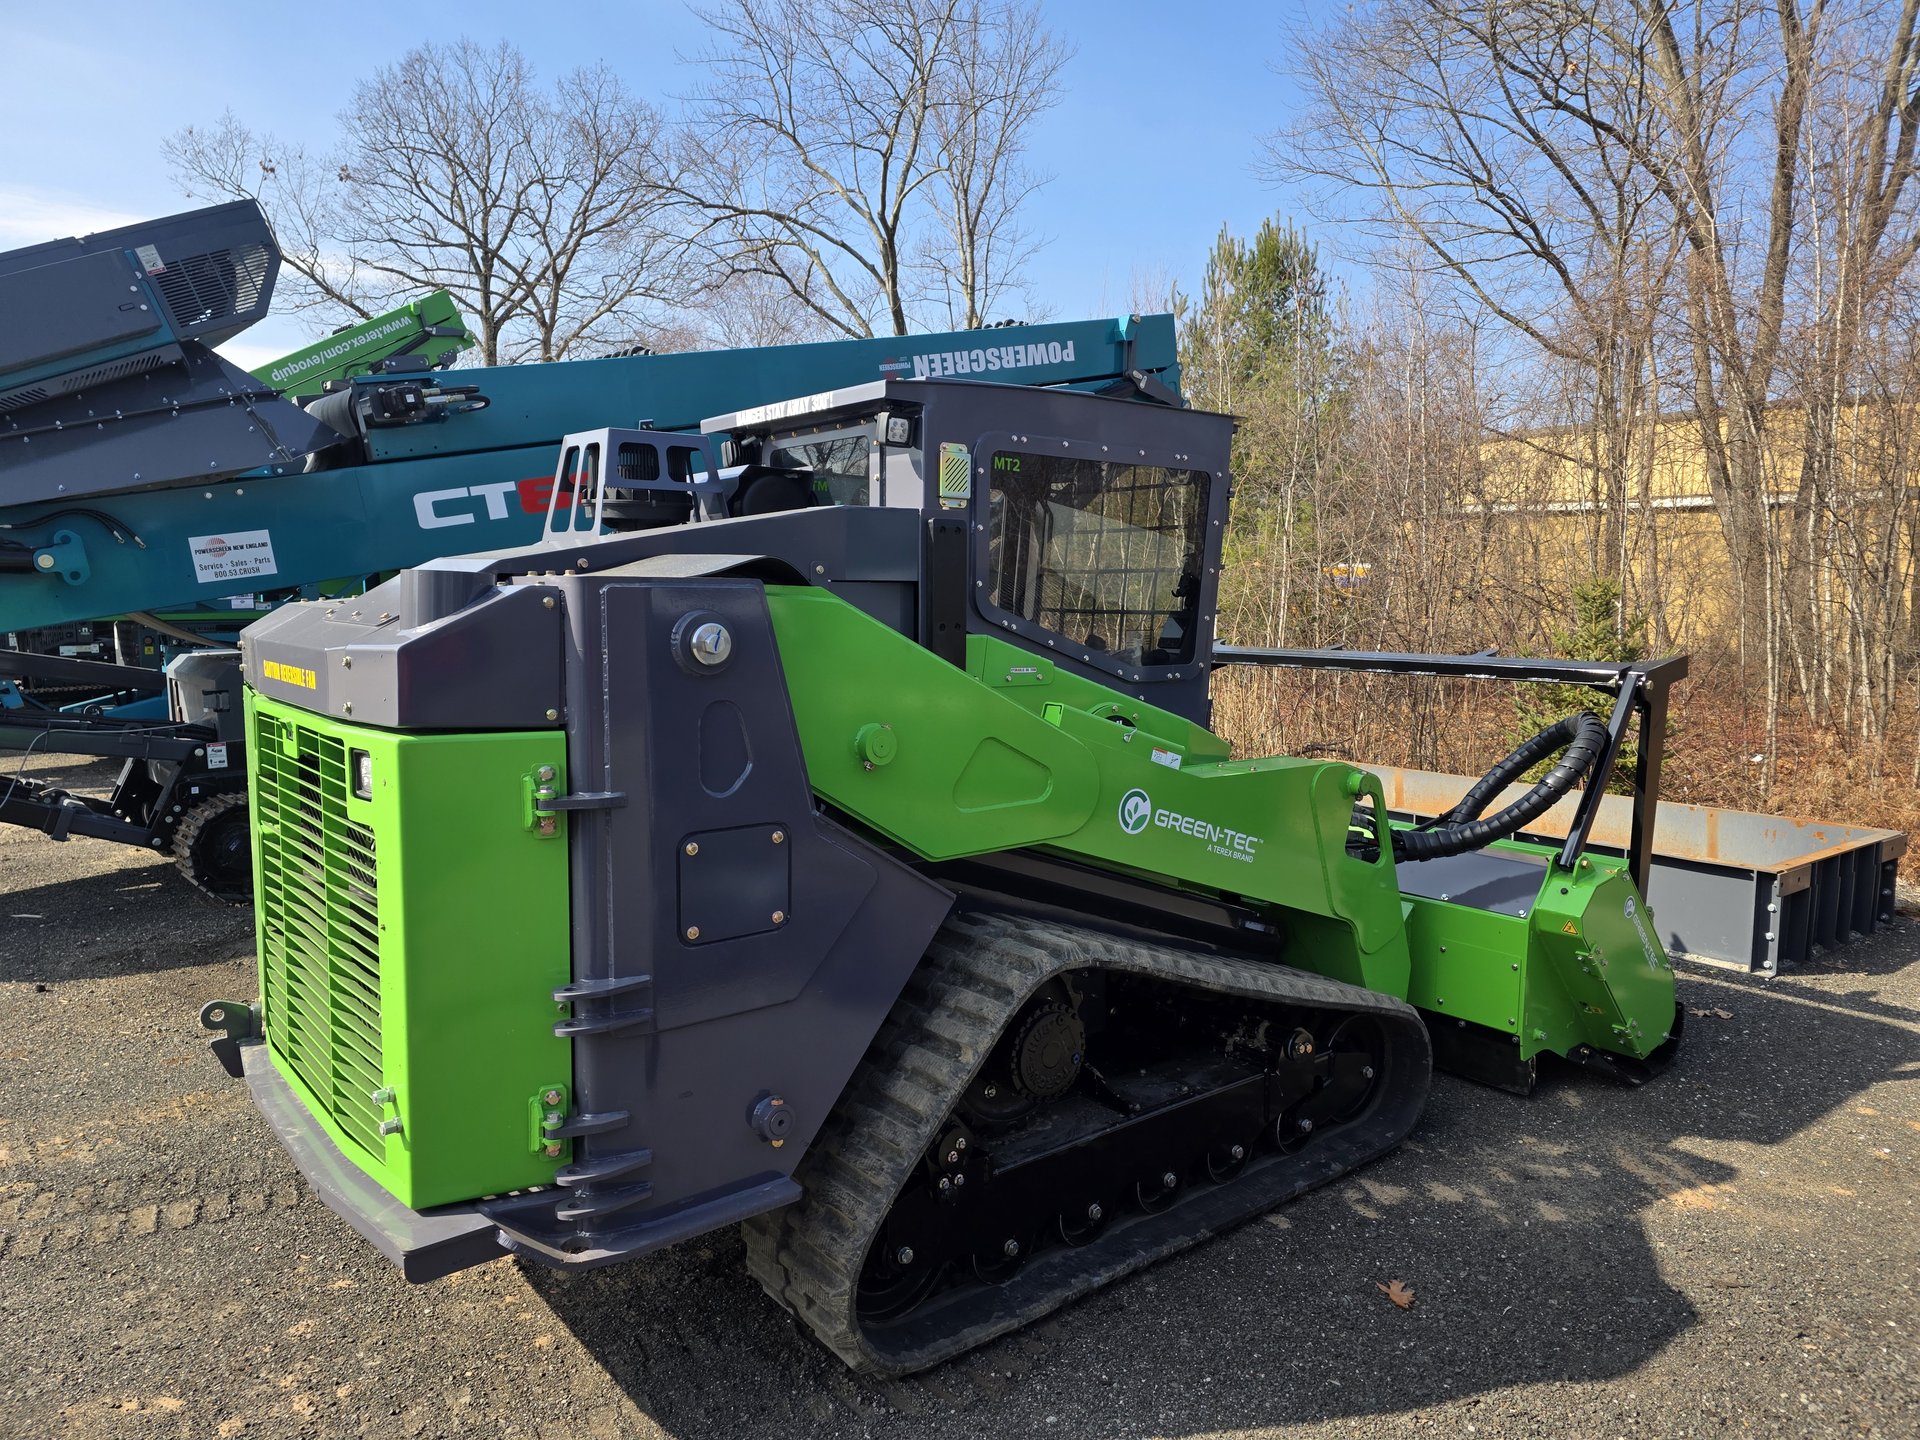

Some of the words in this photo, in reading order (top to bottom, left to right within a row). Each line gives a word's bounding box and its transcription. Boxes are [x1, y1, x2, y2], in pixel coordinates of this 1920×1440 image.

[271, 315, 412, 382] www.terex.com/evoquip
[912, 340, 1076, 378] POWERSCREEN
[766, 402, 785, 420] STAY
[787, 397, 810, 416] AWAY
[994, 456, 1020, 472] MT2
[194, 546, 232, 555] POWERSCREEN
[245, 541, 268, 549] ENGLAND
[199, 562, 223, 571] Service
[230, 560, 248, 568] Sales
[214, 566, 261, 578] 800.53.CRUSH
[1207, 844, 1213, 852] A
[1213, 845, 1232, 858] TEREX
[1232, 851, 1254, 863] BRAND
